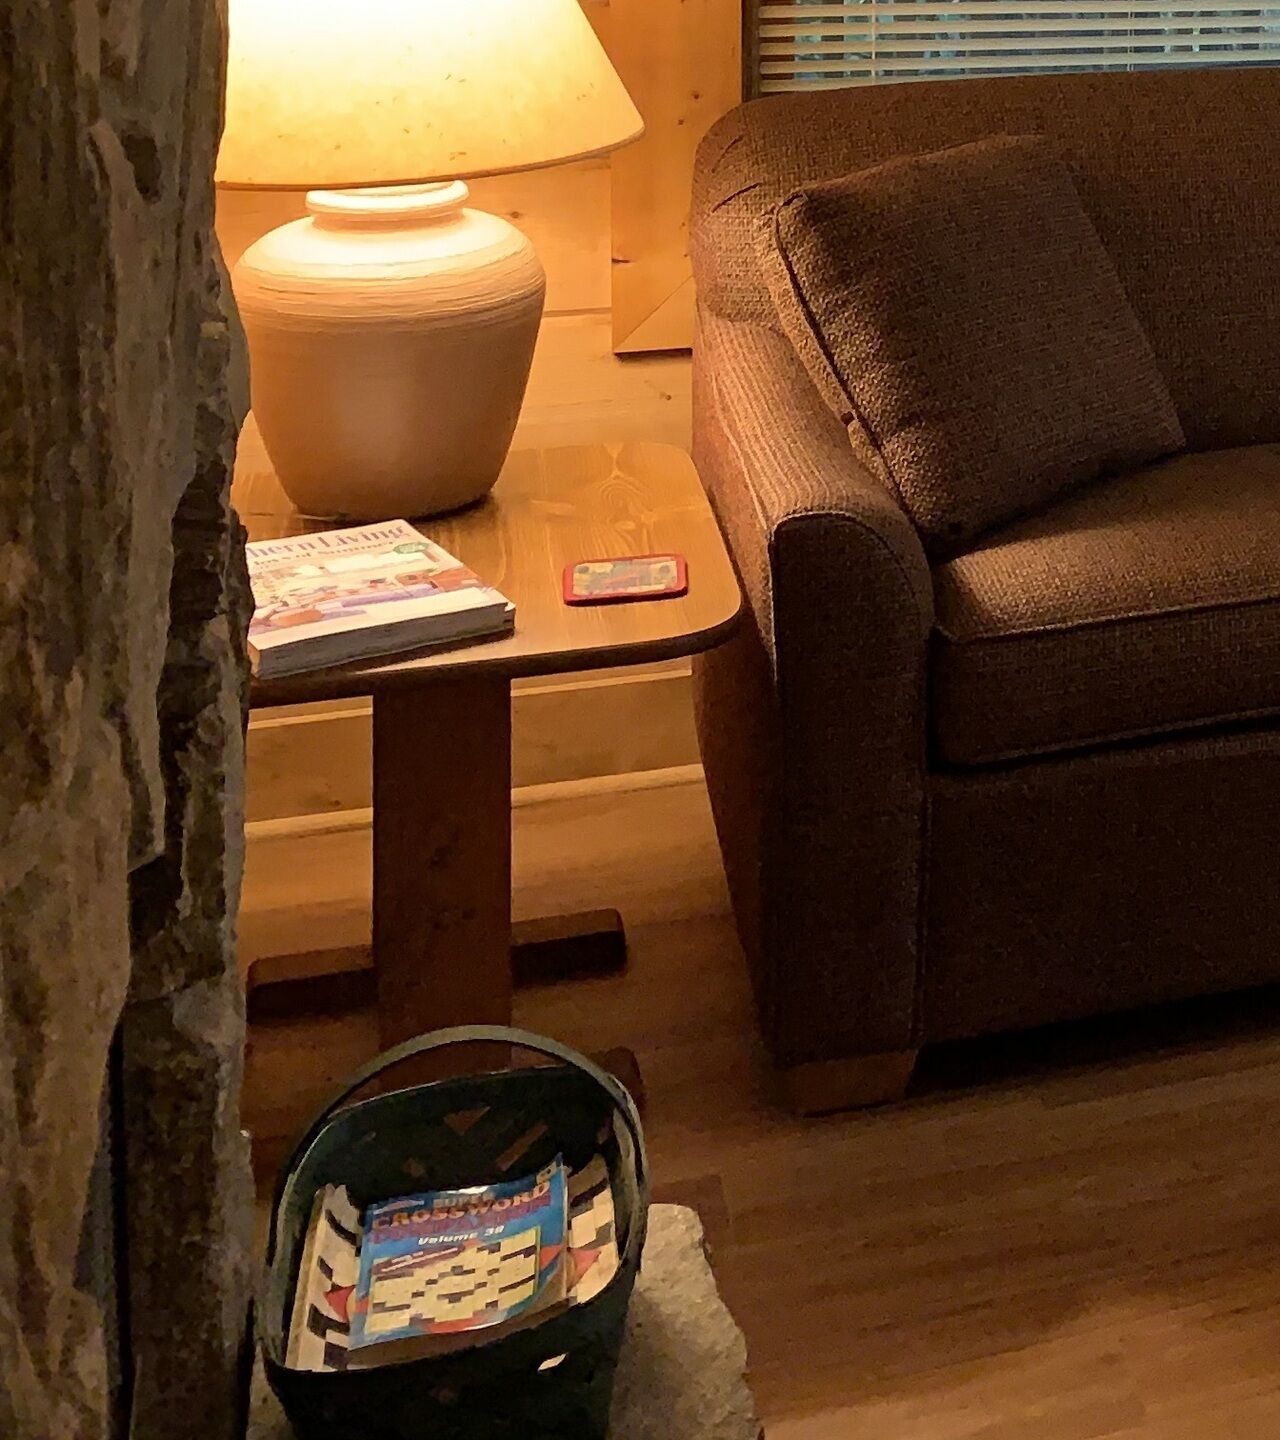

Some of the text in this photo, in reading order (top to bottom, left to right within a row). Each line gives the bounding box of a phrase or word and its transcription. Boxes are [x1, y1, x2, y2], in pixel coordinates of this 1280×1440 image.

[318, 525, 411, 548] Living
[372, 1180, 551, 1228] CROSSWORD
[418, 1231, 479, 1246] Volume
